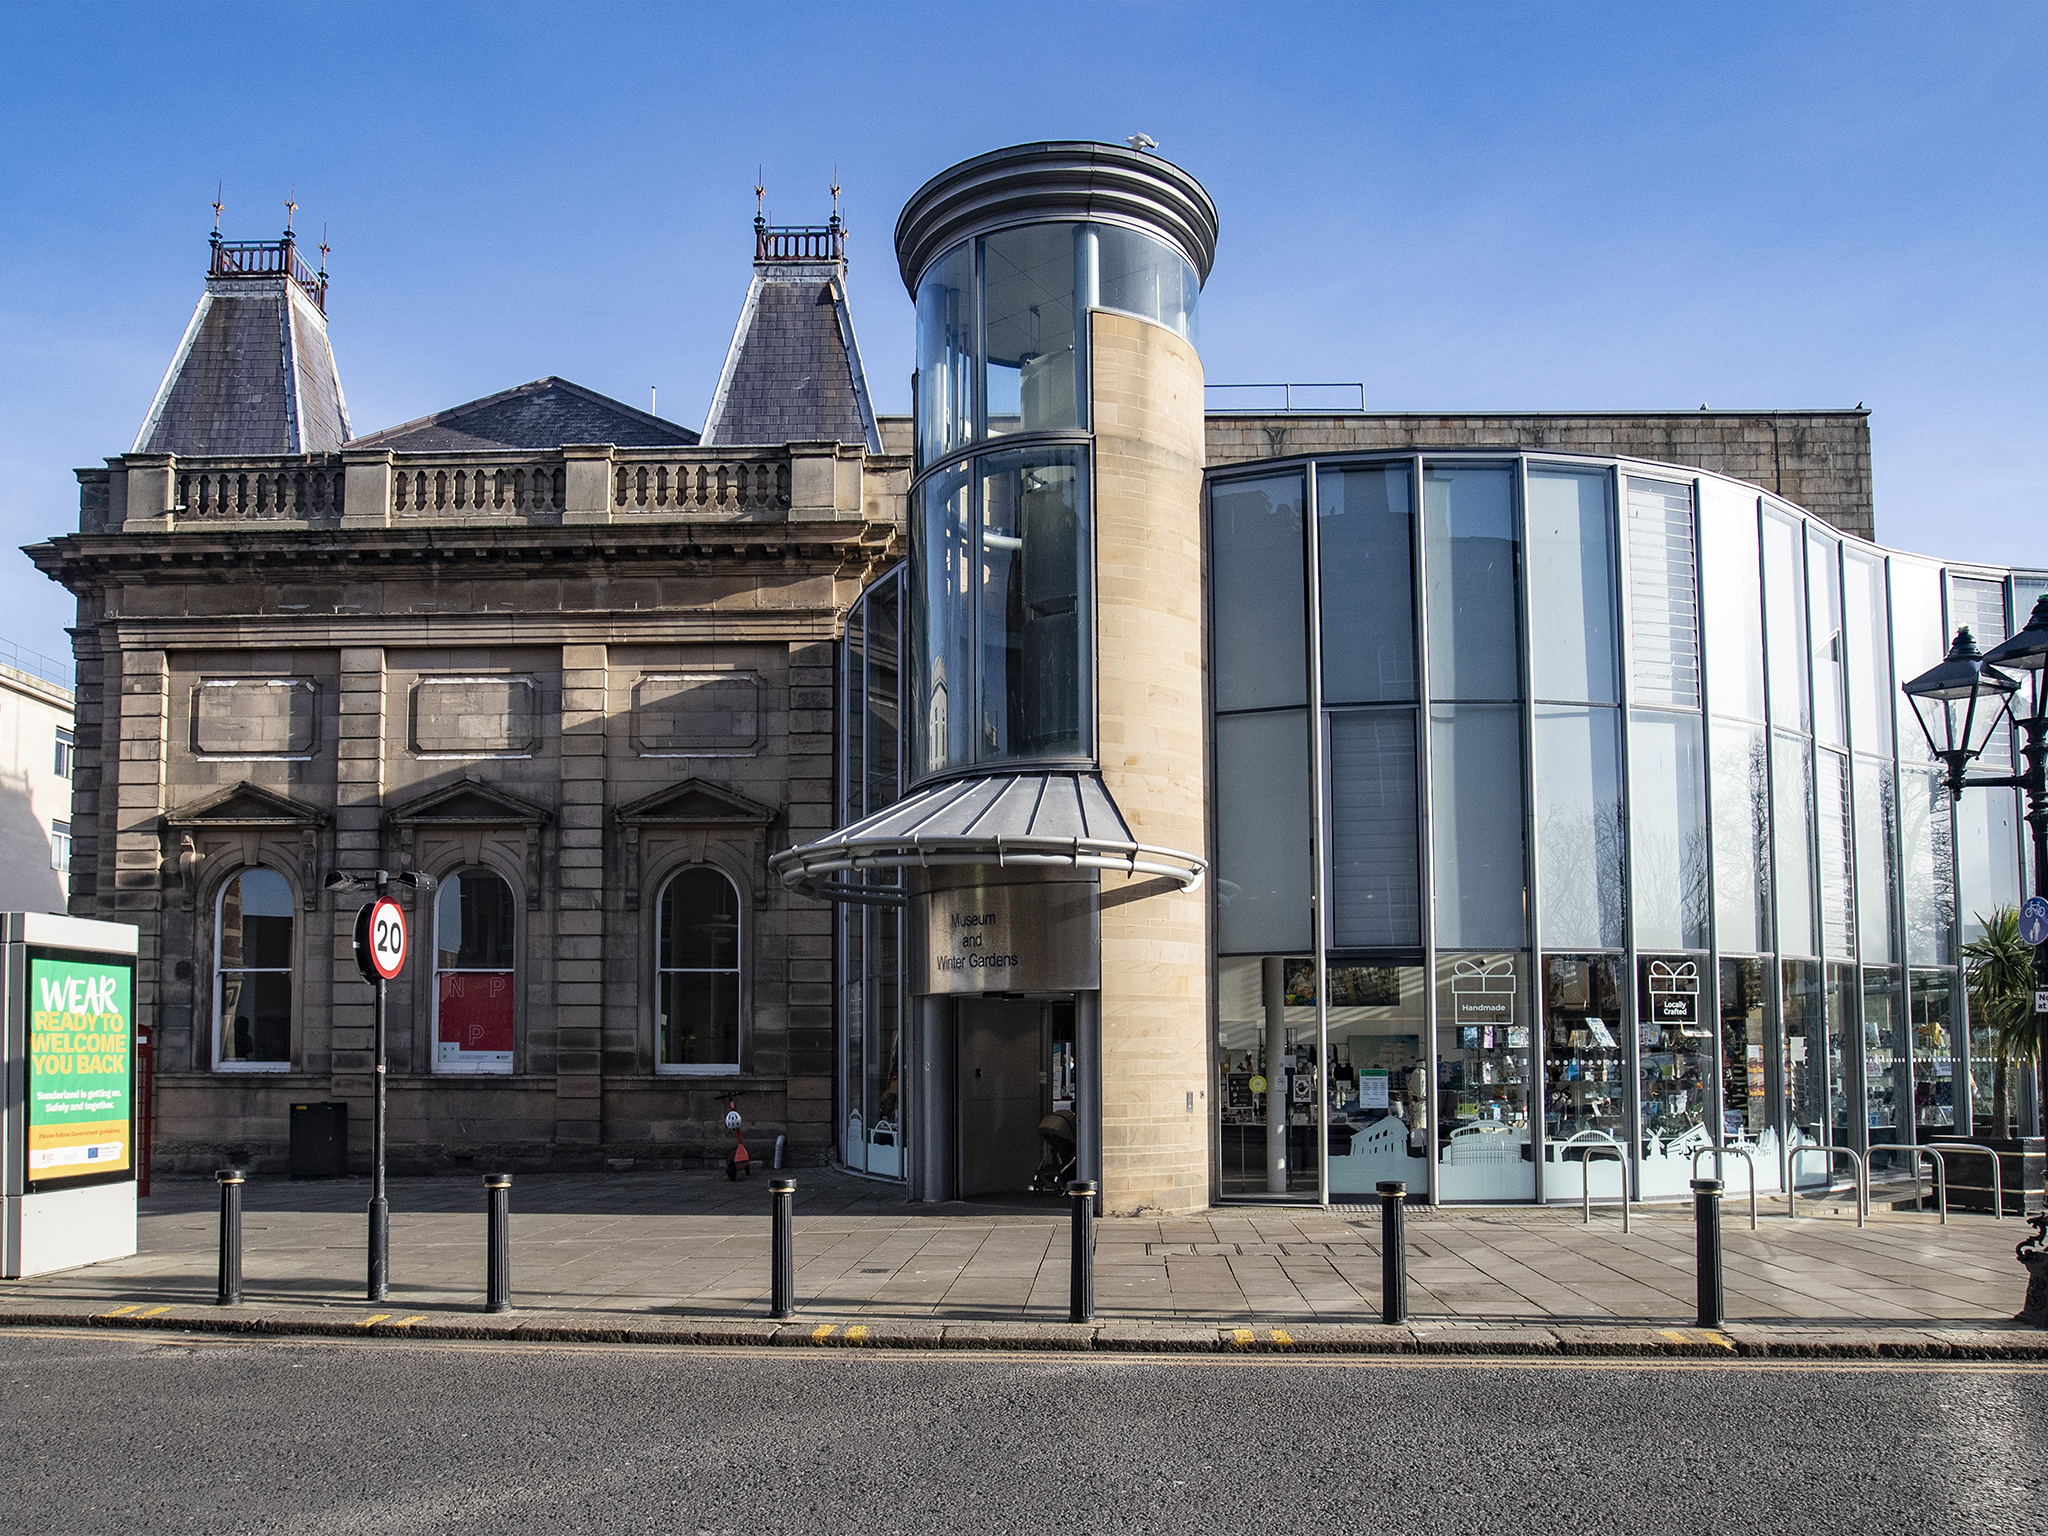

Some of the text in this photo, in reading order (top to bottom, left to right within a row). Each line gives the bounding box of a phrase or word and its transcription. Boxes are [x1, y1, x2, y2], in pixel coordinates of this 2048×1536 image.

[950, 913, 996, 928] Museum
[377, 919, 402, 955] 20
[962, 932, 982, 948] and
[937, 953, 1019, 971] Winter Gardens
[40, 974, 119, 1016] WEAR
[1664, 1000, 1687, 1009] Locally
[34, 1011, 124, 1032] READY TO
[31, 1033, 127, 1053] WELCOME
[32, 1054, 125, 1075] YOU BACK
[36, 1088, 122, 1100] Sunderland is getting on.
[45, 1100, 115, 1114] Safely and together.
[71, 1129, 98, 1137] Government
[99, 1128, 120, 1136] guidelines
